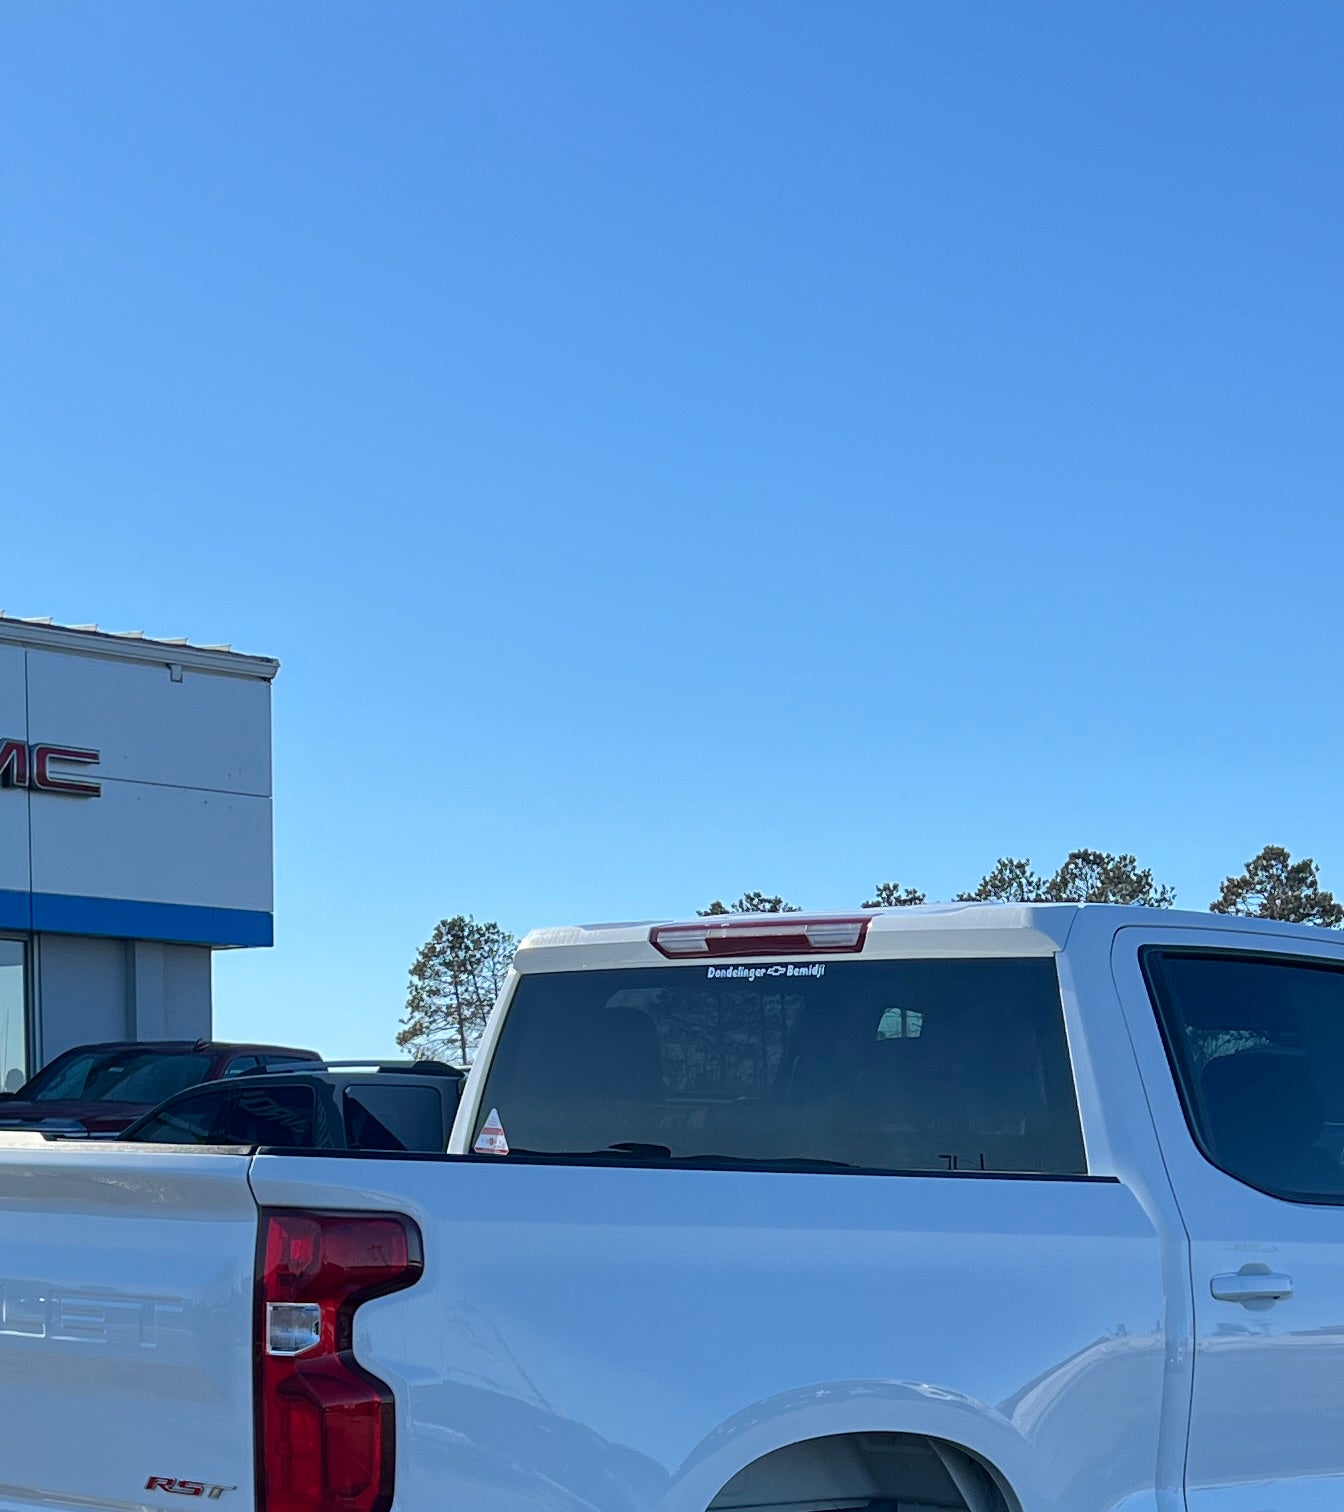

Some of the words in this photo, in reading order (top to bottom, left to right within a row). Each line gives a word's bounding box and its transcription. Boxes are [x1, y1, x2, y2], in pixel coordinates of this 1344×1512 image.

[707, 966, 766, 981] Dondelinger
[787, 964, 826, 979] Bemidji
[144, 1476, 238, 1499] RST
